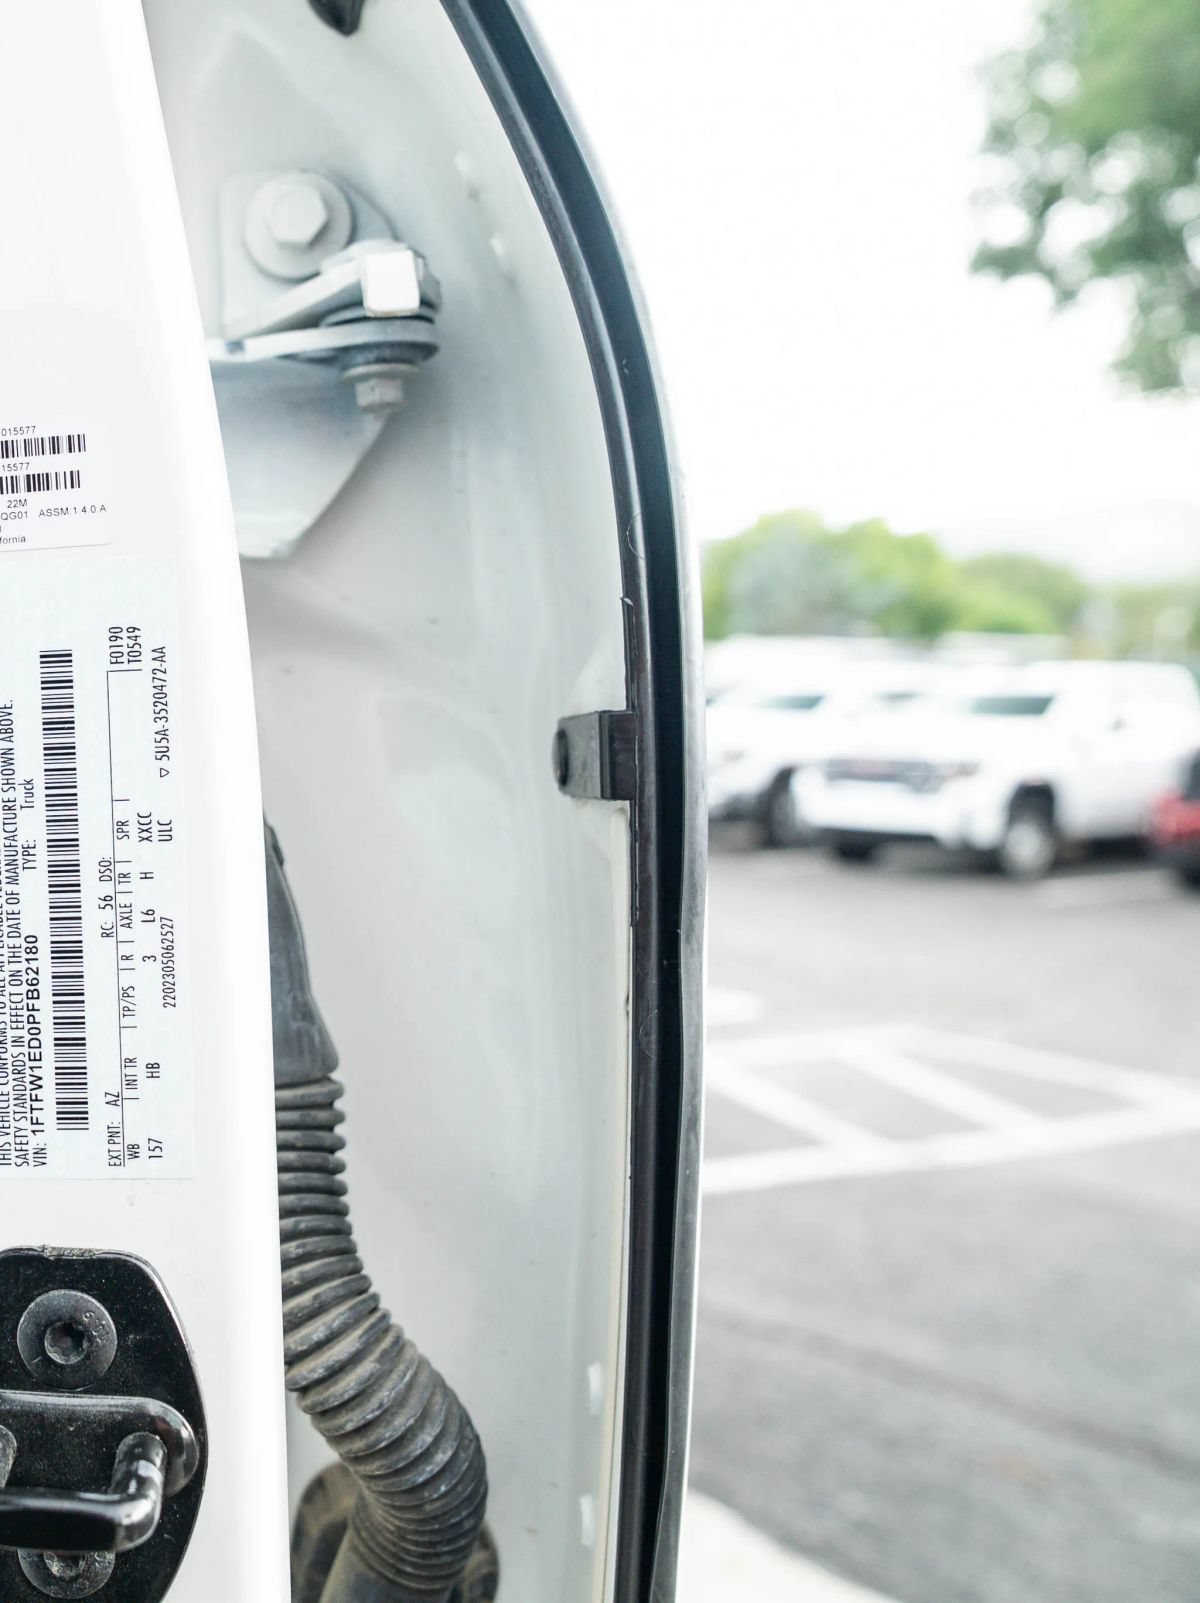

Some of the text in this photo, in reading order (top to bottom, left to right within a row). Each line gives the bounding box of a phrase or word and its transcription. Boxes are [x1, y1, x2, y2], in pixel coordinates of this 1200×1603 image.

[6, 499, 28, 509] 22M
[0, 747, 16, 793] SHOWN
[17, 778, 37, 872] TYPE: Truck
[116, 820, 130, 840] SPR
[137, 812, 153, 843] XXCC
[151, 646, 176, 1008] 2202305062527 ULC 5U5A-3520472-AA
[1, 797, 20, 886] MANUFACTURE
[117, 872, 131, 885] TR
[139, 871, 154, 880] H
[5, 890, 20, 905] OF
[98, 895, 114, 910] 56
[5, 909, 22, 939] DATE
[119, 903, 133, 929] AXLE
[140, 909, 156, 923] L6
[100, 922, 115, 938] RC:
[7, 943, 23, 965] THE
[8, 970, 23, 987] ON
[8, 991, 25, 1030] EFFECT
[120, 985, 137, 1019] TP/PS
[10, 1036, 25, 1047] IN
[24, 934, 47, 1167] VIN: 1FTFW1ED0PFB62180
[124, 1057, 137, 1070] TR
[145, 1062, 160, 1079] HB
[11, 1052, 28, 1122] STANDARDS
[124, 1073, 138, 1090] INT
[104, 1091, 122, 1167] EXT PNT: AZ
[13, 1126, 30, 1167] SAFETY
[126, 1143, 140, 1160] WB
[147, 1138, 163, 1159] 157
